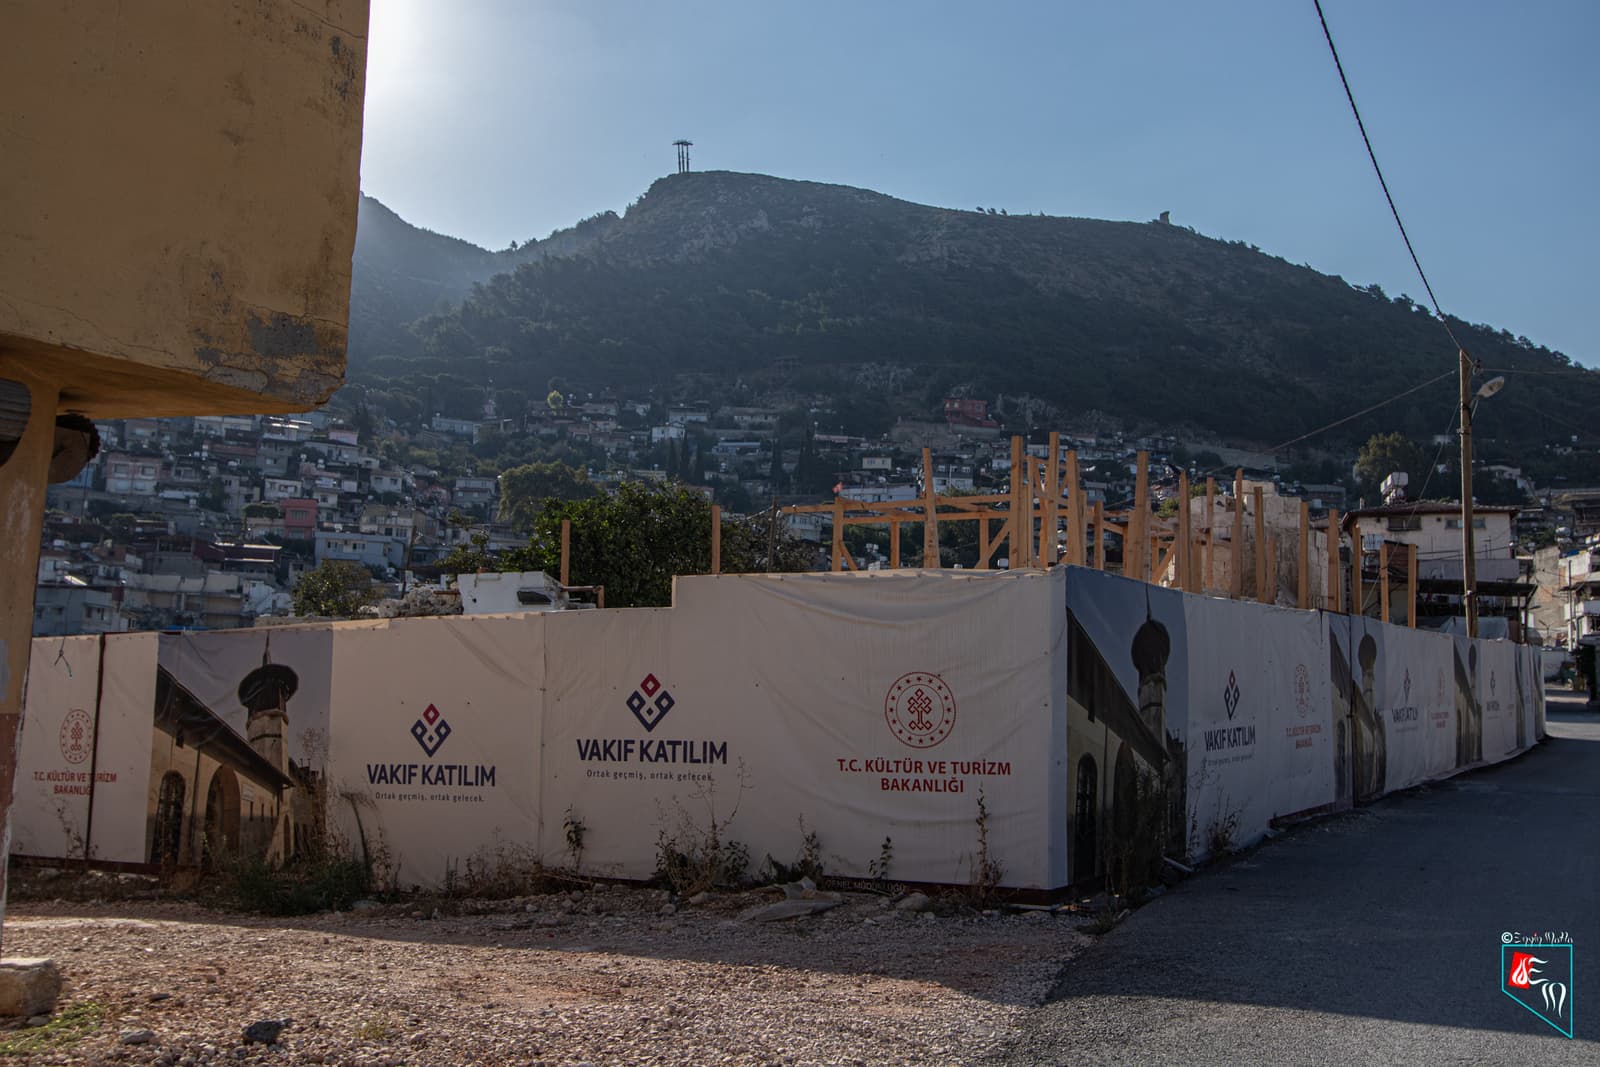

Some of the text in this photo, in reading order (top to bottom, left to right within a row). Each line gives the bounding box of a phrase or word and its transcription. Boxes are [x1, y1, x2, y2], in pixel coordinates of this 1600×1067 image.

[1204, 728, 1226, 752] VAKIF
[576, 739, 728, 764] VAKIF KATILIM
[367, 764, 496, 787] VAKIF KATILIM
[586, 769, 611, 778] Ortak
[650, 771, 674, 780] ortak
[837, 757, 1011, 776] T.C. KÜLTÜR VE TURİZM
[77, 772, 86, 782] VE
[881, 777, 964, 793] BAKANLIĞI
